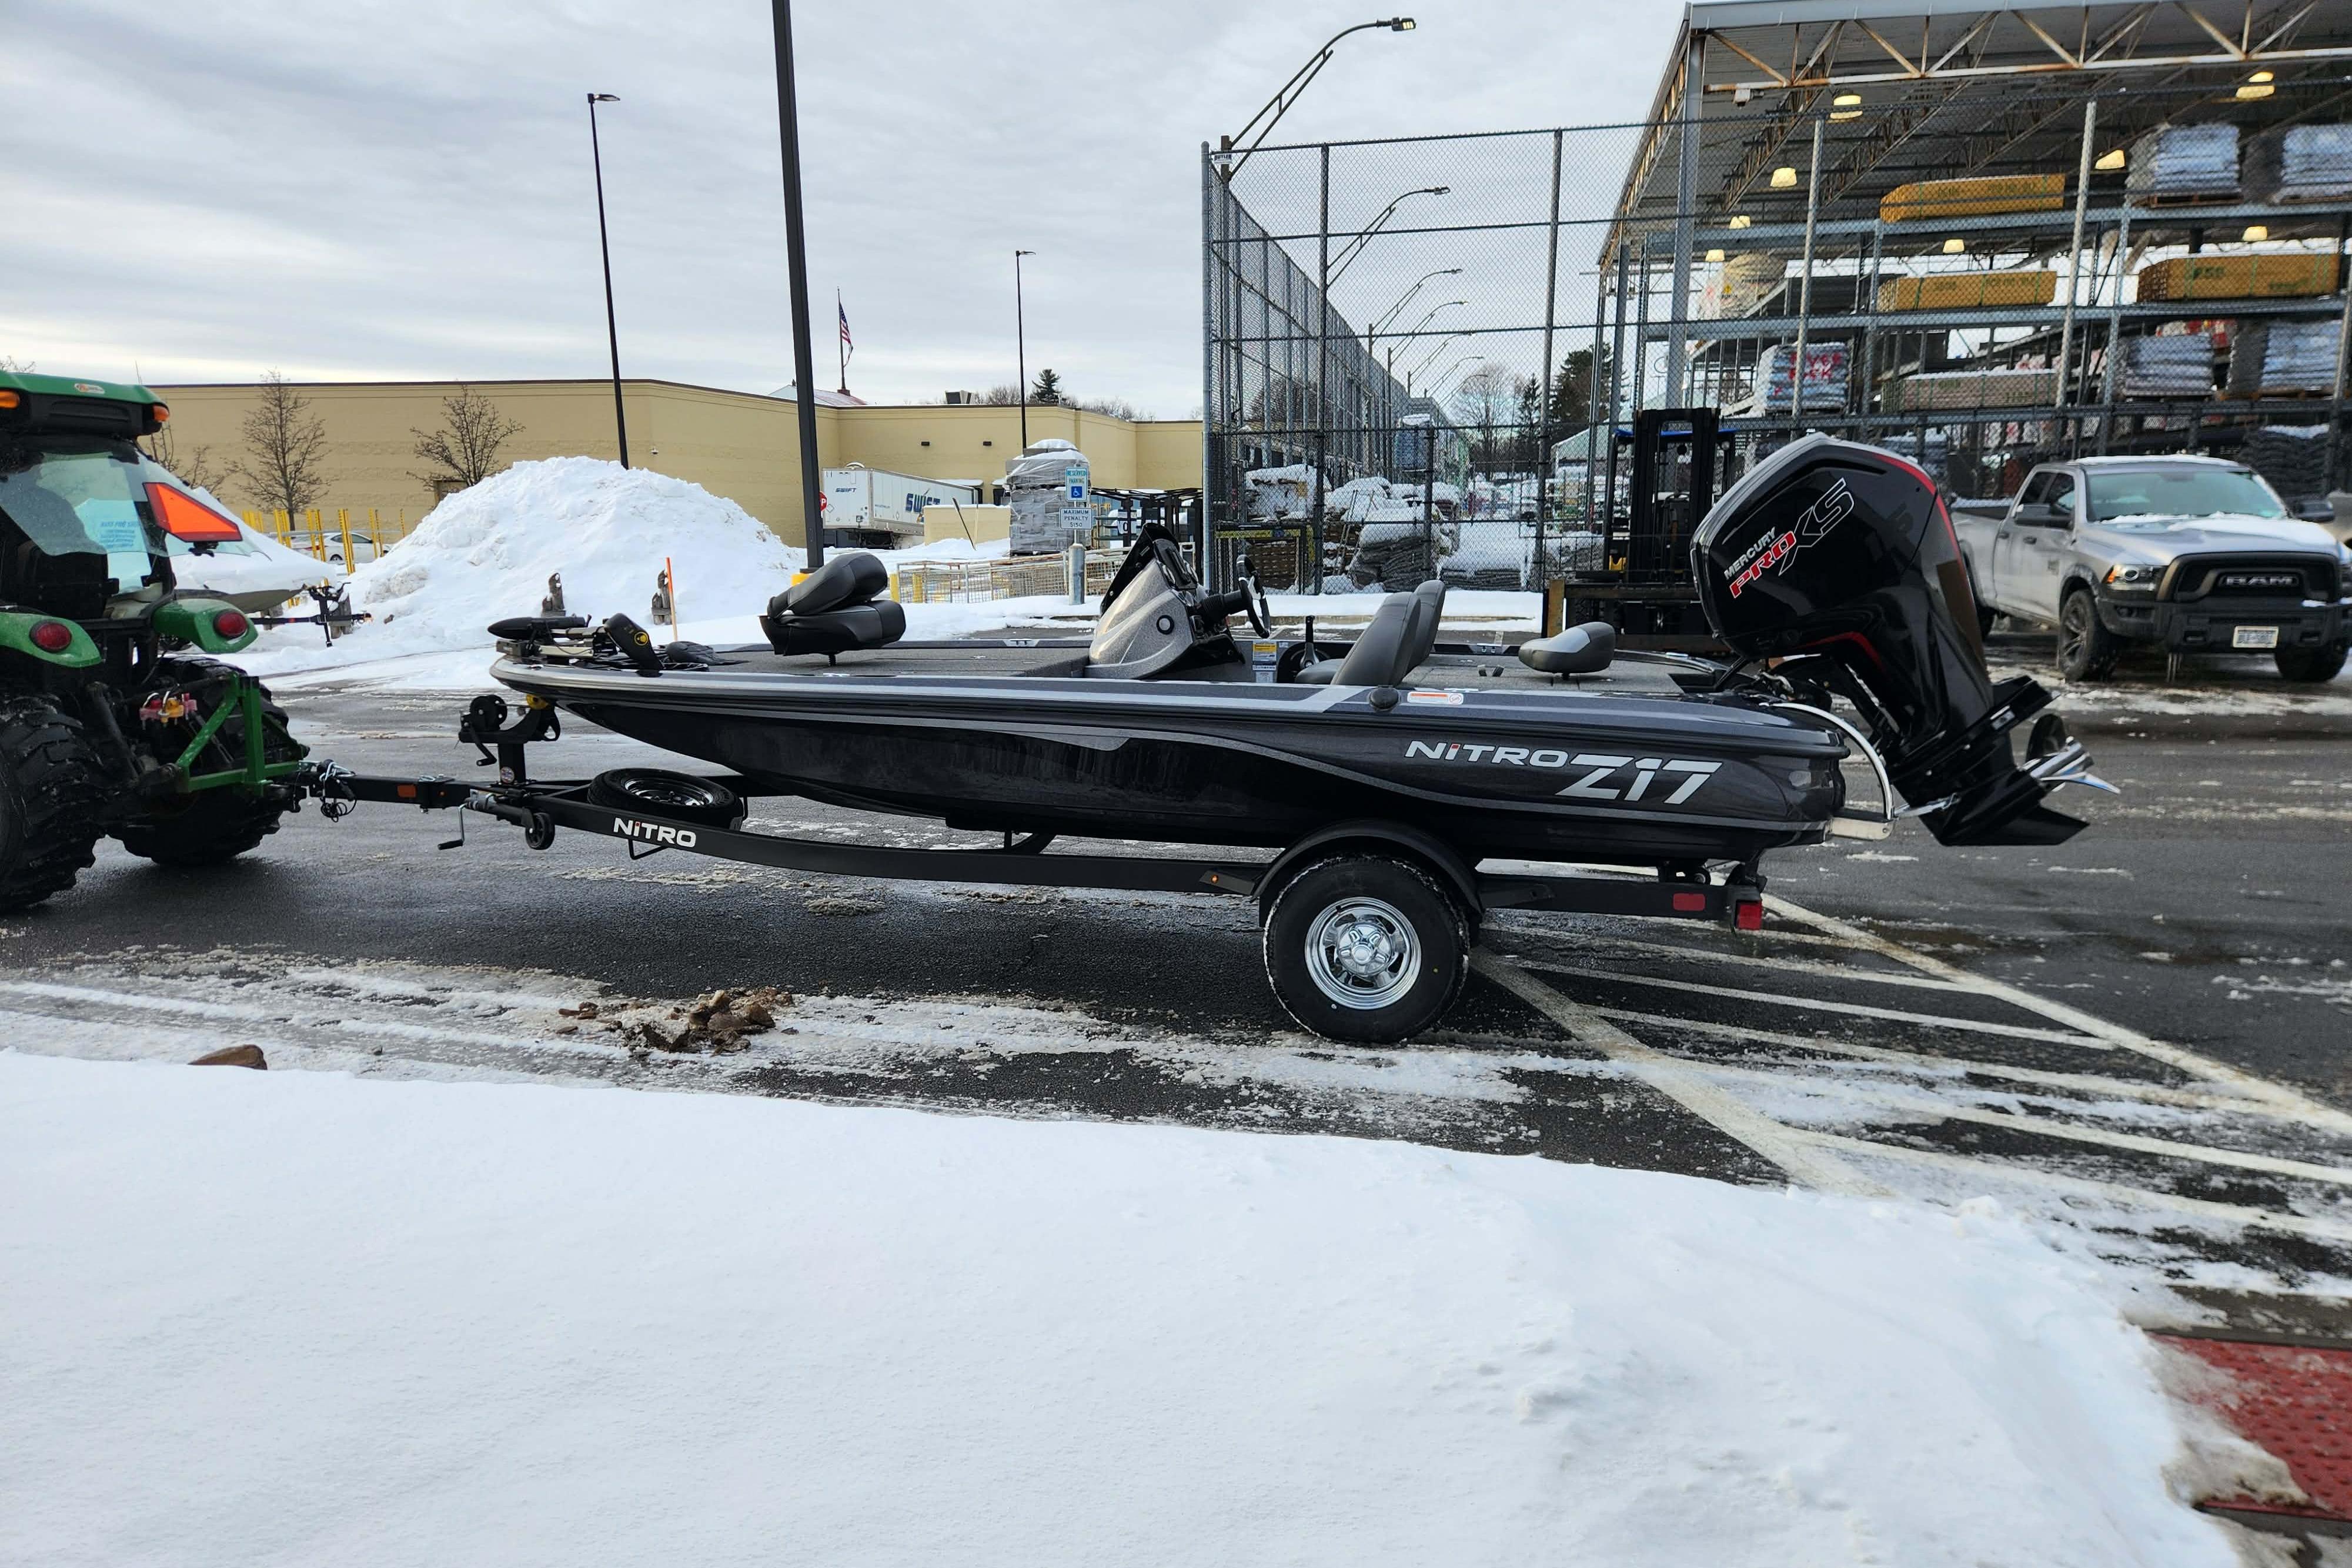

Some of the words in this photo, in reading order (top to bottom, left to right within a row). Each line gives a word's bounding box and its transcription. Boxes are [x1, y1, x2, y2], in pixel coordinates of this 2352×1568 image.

[1723, 527, 1776, 580] MERCURY
[1729, 530, 1797, 599] PRO
[2226, 576, 2293, 585] RAM
[1555, 754, 1723, 804] Z17
